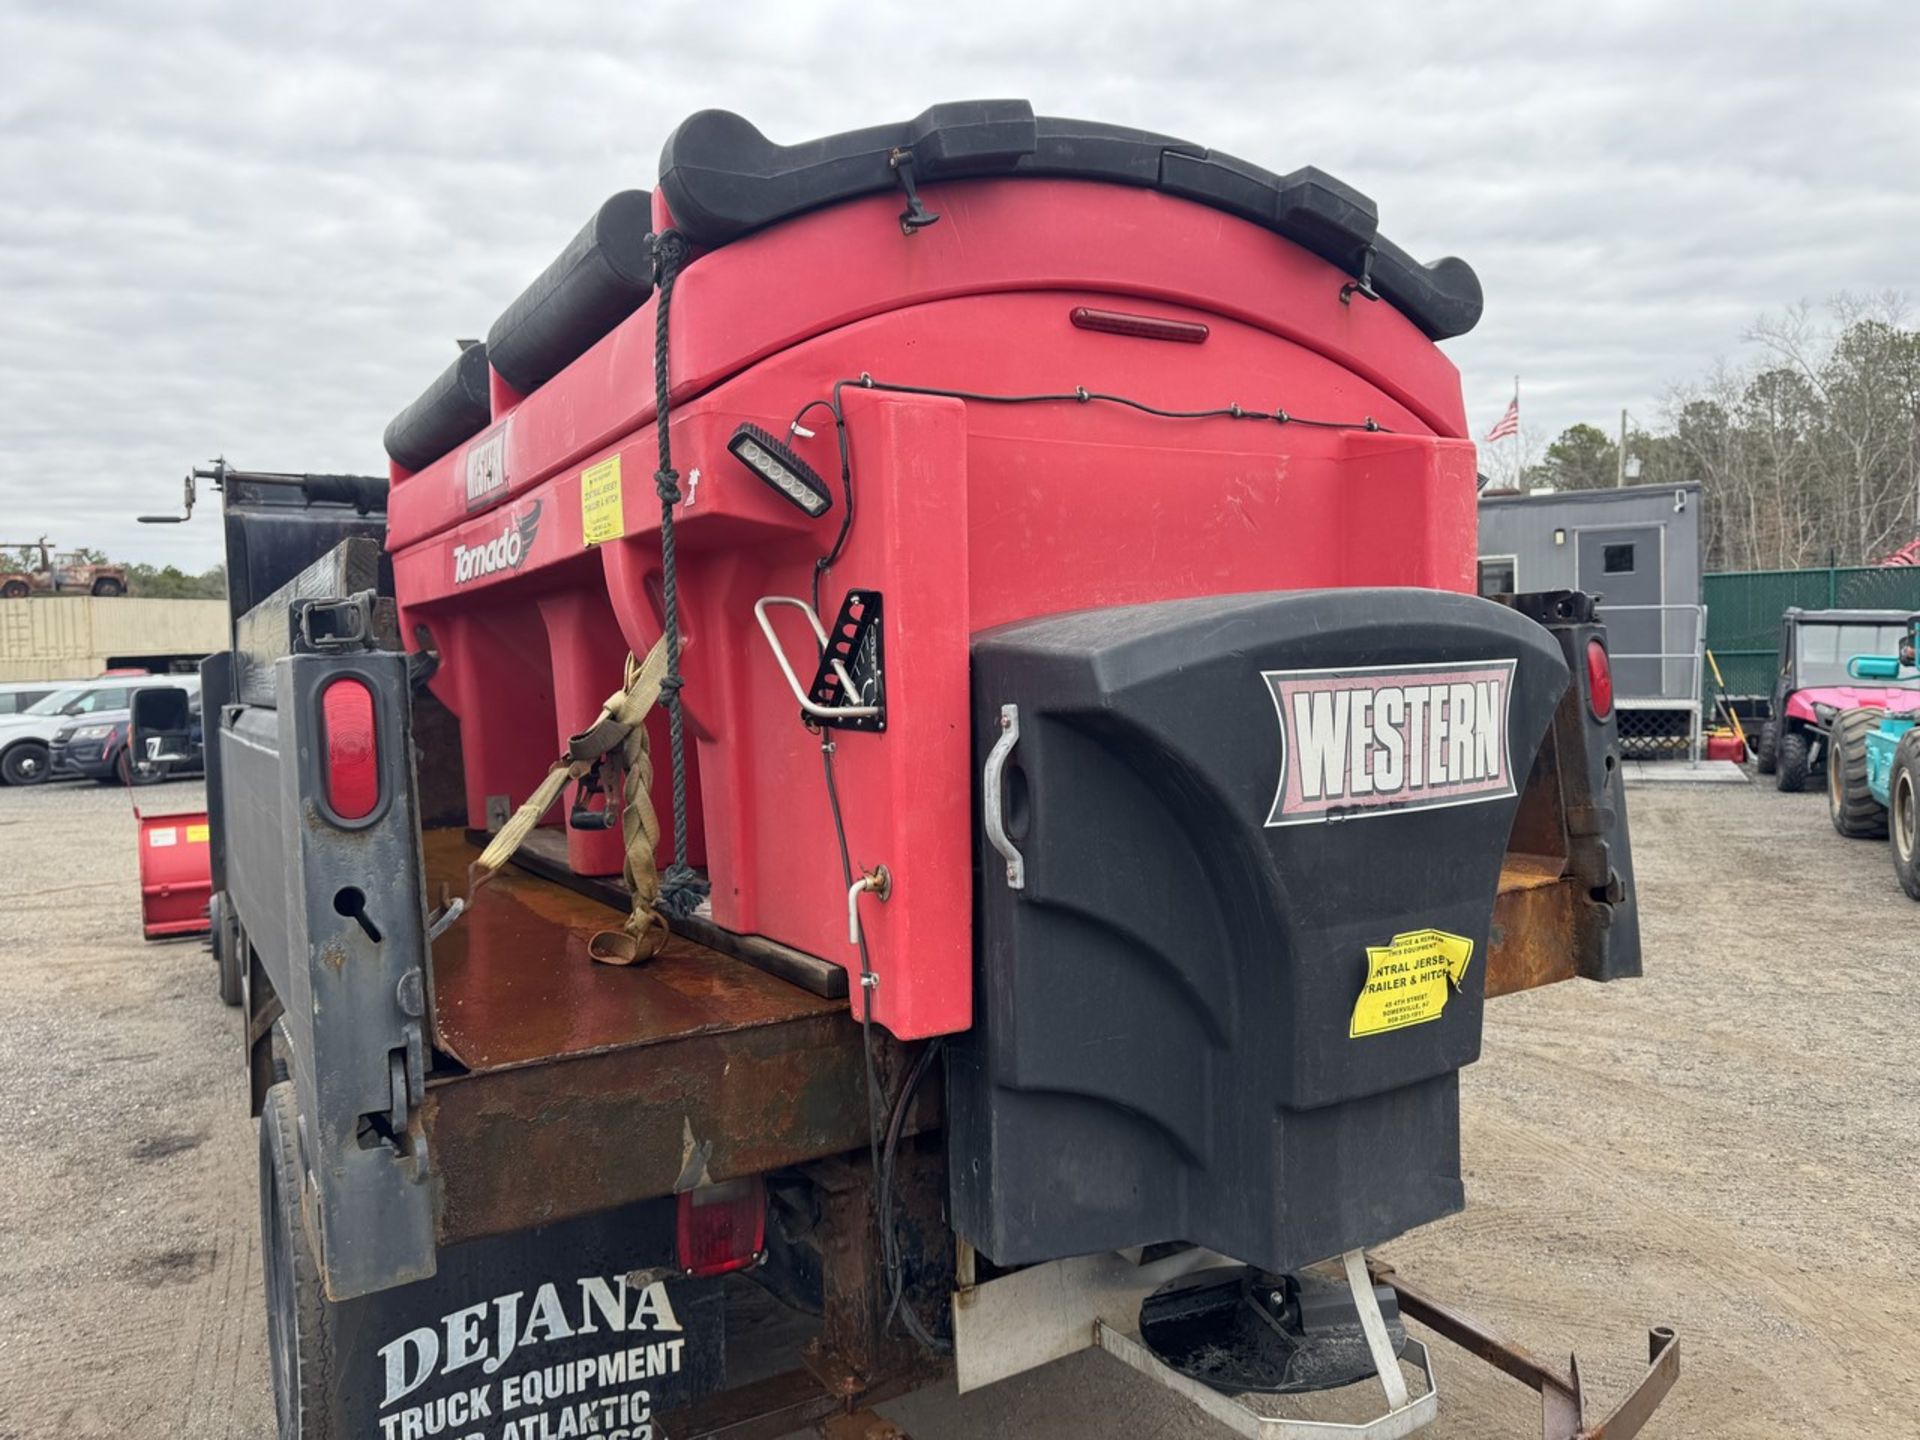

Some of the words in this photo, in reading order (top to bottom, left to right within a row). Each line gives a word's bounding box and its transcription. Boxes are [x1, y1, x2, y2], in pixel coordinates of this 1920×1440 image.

[454, 527, 521, 583] Tornado
[1294, 680, 1500, 798] WESTERN
[1373, 962, 1411, 978] NTRAL
[1414, 955, 1454, 970] JERSEY
[1403, 942, 1437, 955] EQUIPMENT
[1410, 975, 1417, 985] &
[377, 1274, 683, 1409] DEJANA
[379, 1384, 492, 1440] TRUCK
[502, 1338, 685, 1412] EQUIPMENT
[503, 1390, 651, 1440] ATLANTIC
